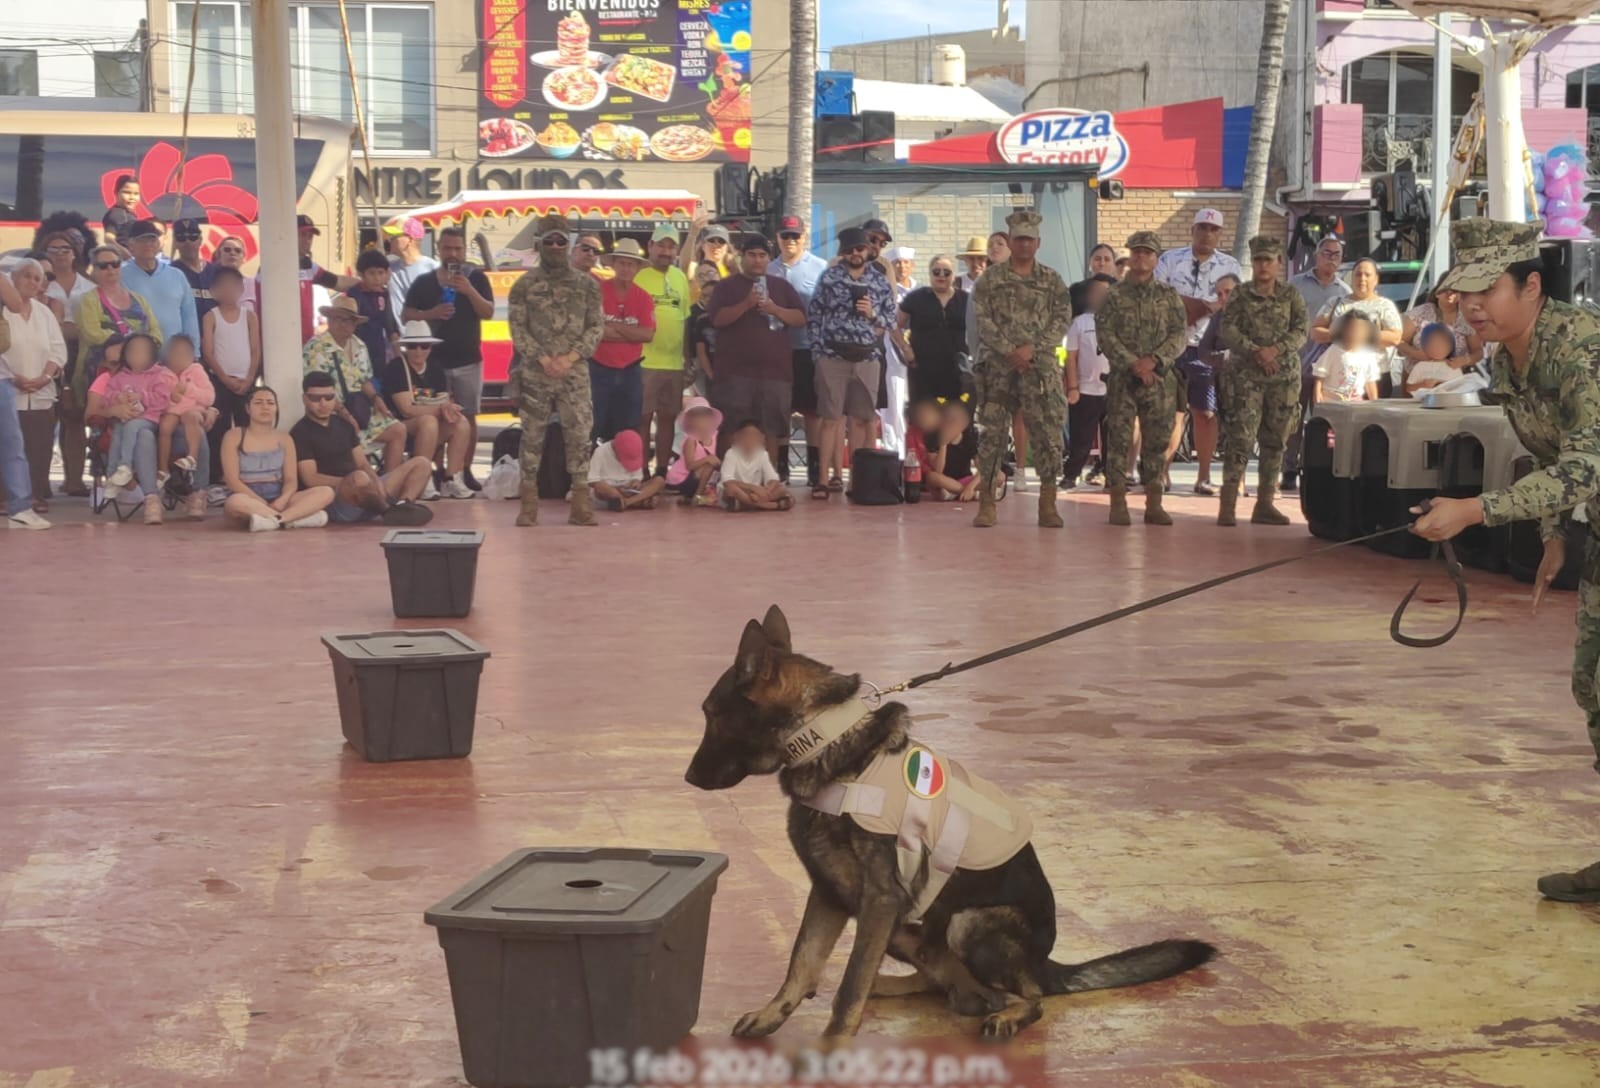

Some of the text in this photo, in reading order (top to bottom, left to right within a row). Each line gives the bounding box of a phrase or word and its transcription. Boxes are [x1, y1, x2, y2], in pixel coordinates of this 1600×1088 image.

[547, 0, 660, 11] BIENVENIDOS
[680, 21, 710, 31] CERVEZA
[683, 31, 705, 40] VODKA
[681, 49, 708, 58] TEQUILA
[681, 59, 707, 68] MEZCAL
[787, 728, 825, 760] RINA
